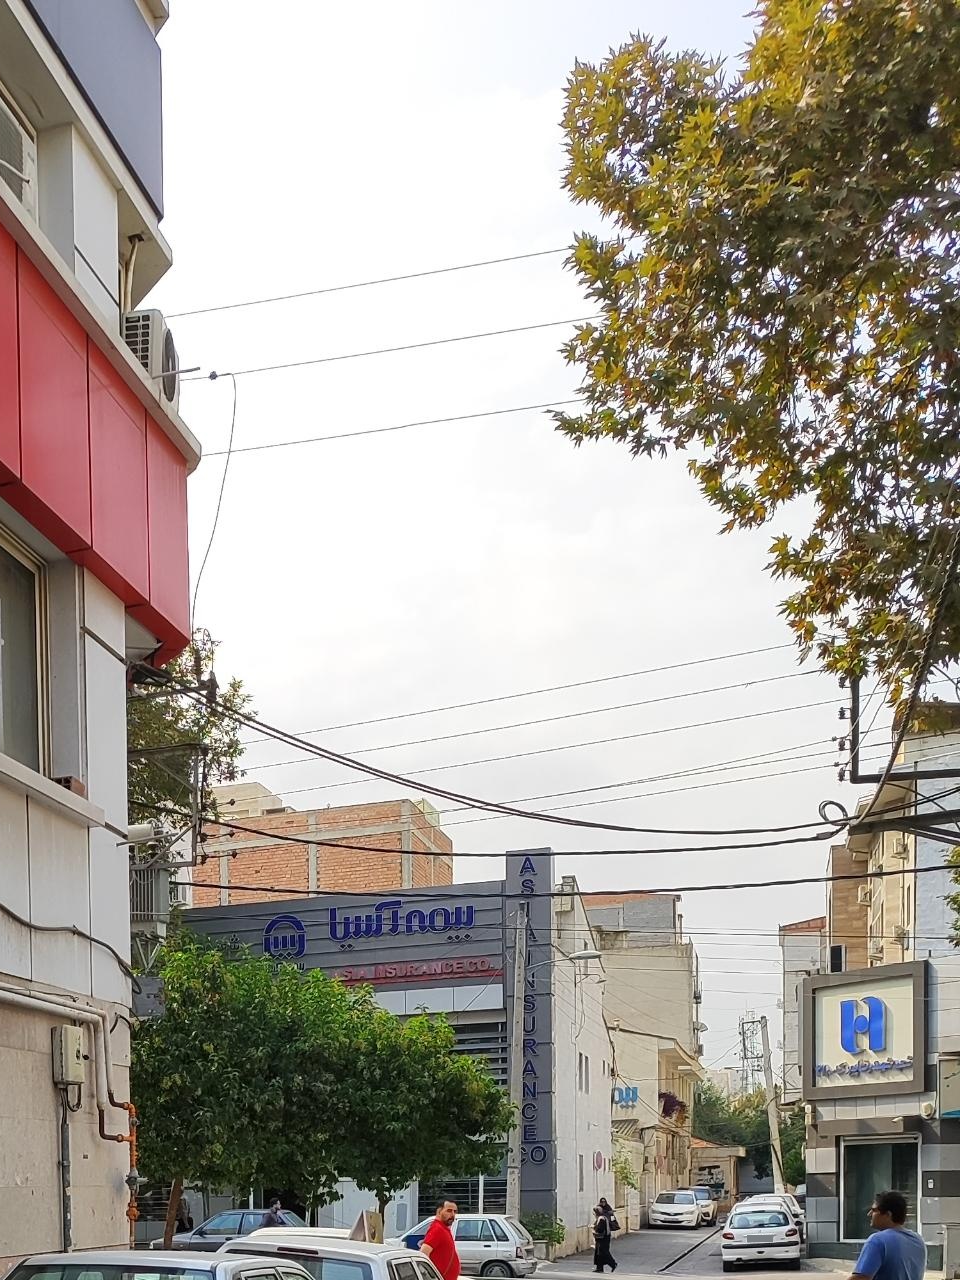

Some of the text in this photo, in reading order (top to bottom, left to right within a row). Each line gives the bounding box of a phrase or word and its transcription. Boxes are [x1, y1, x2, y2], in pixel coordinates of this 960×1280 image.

[328, 900, 475, 951] بیمه آسیا
[373, 960, 464, 978] INSURANCE
[611, 1086, 638, 1109] بیم
